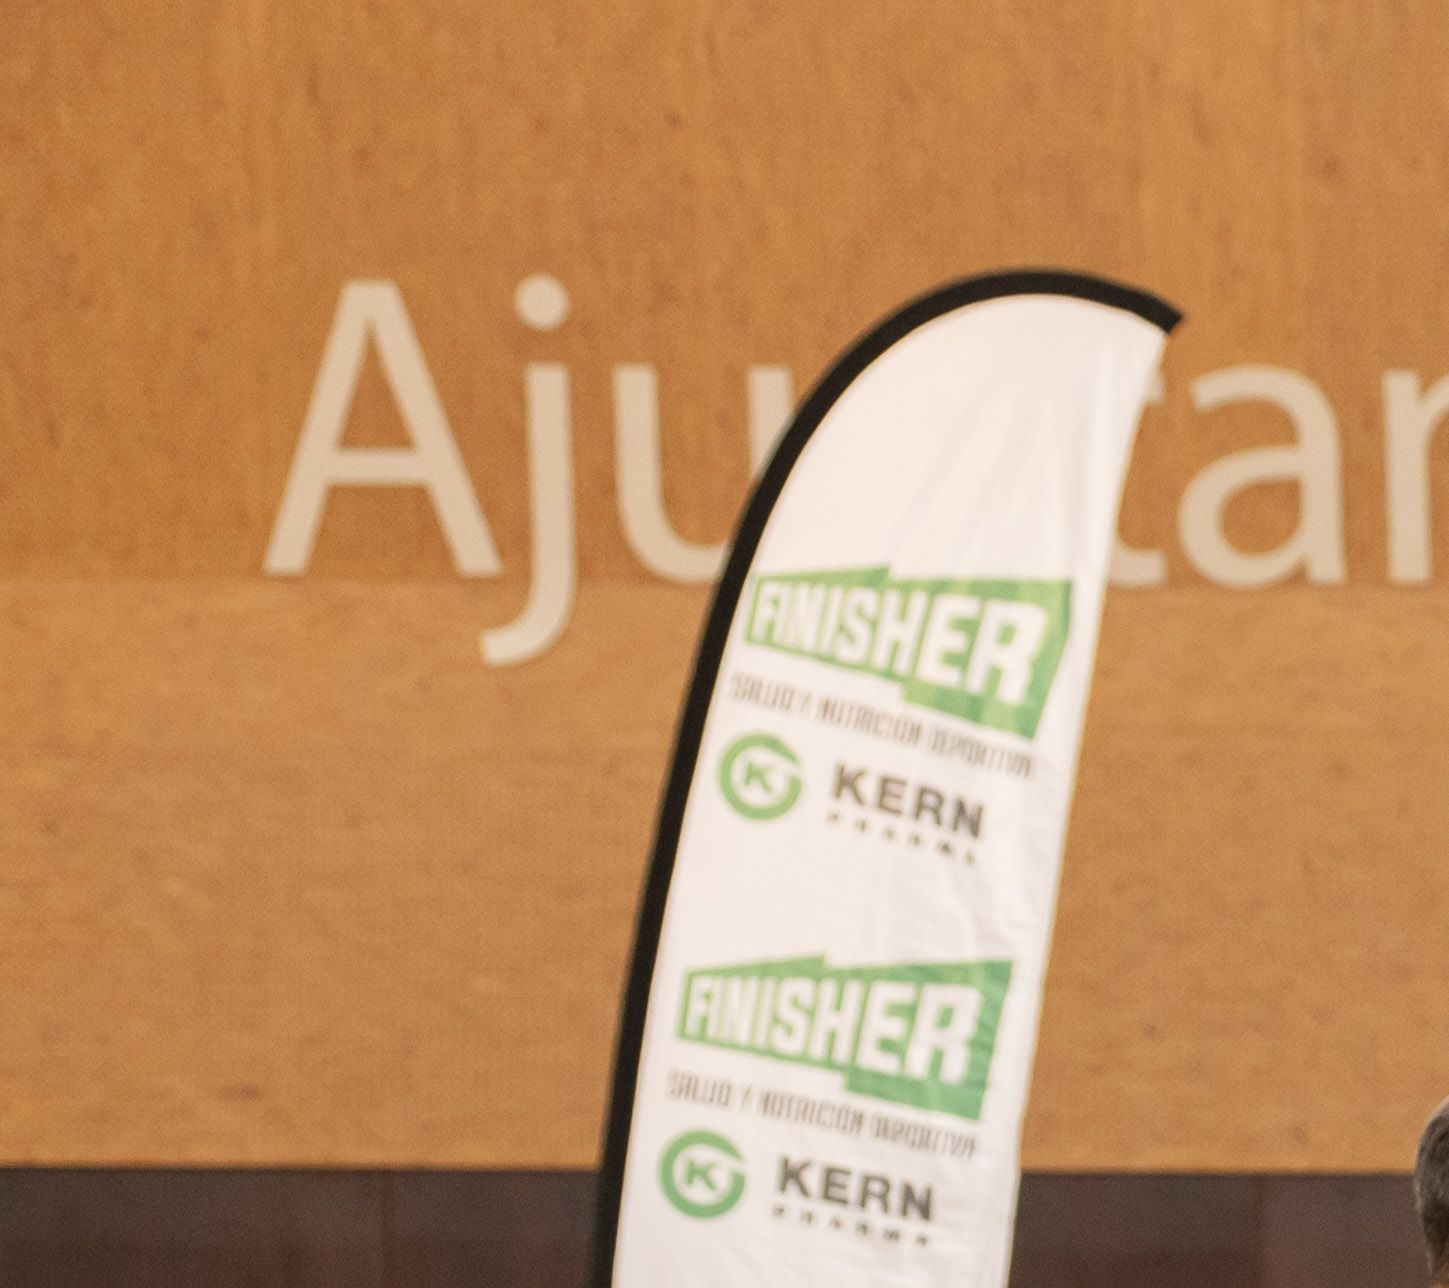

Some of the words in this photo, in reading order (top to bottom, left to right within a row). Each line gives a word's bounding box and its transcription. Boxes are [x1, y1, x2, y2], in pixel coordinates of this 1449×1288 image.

[750, 580, 1050, 706] FINISHER
[831, 760, 985, 840] KERN
[684, 974, 983, 1085] FINISHER
[777, 1154, 934, 1222] KERN
